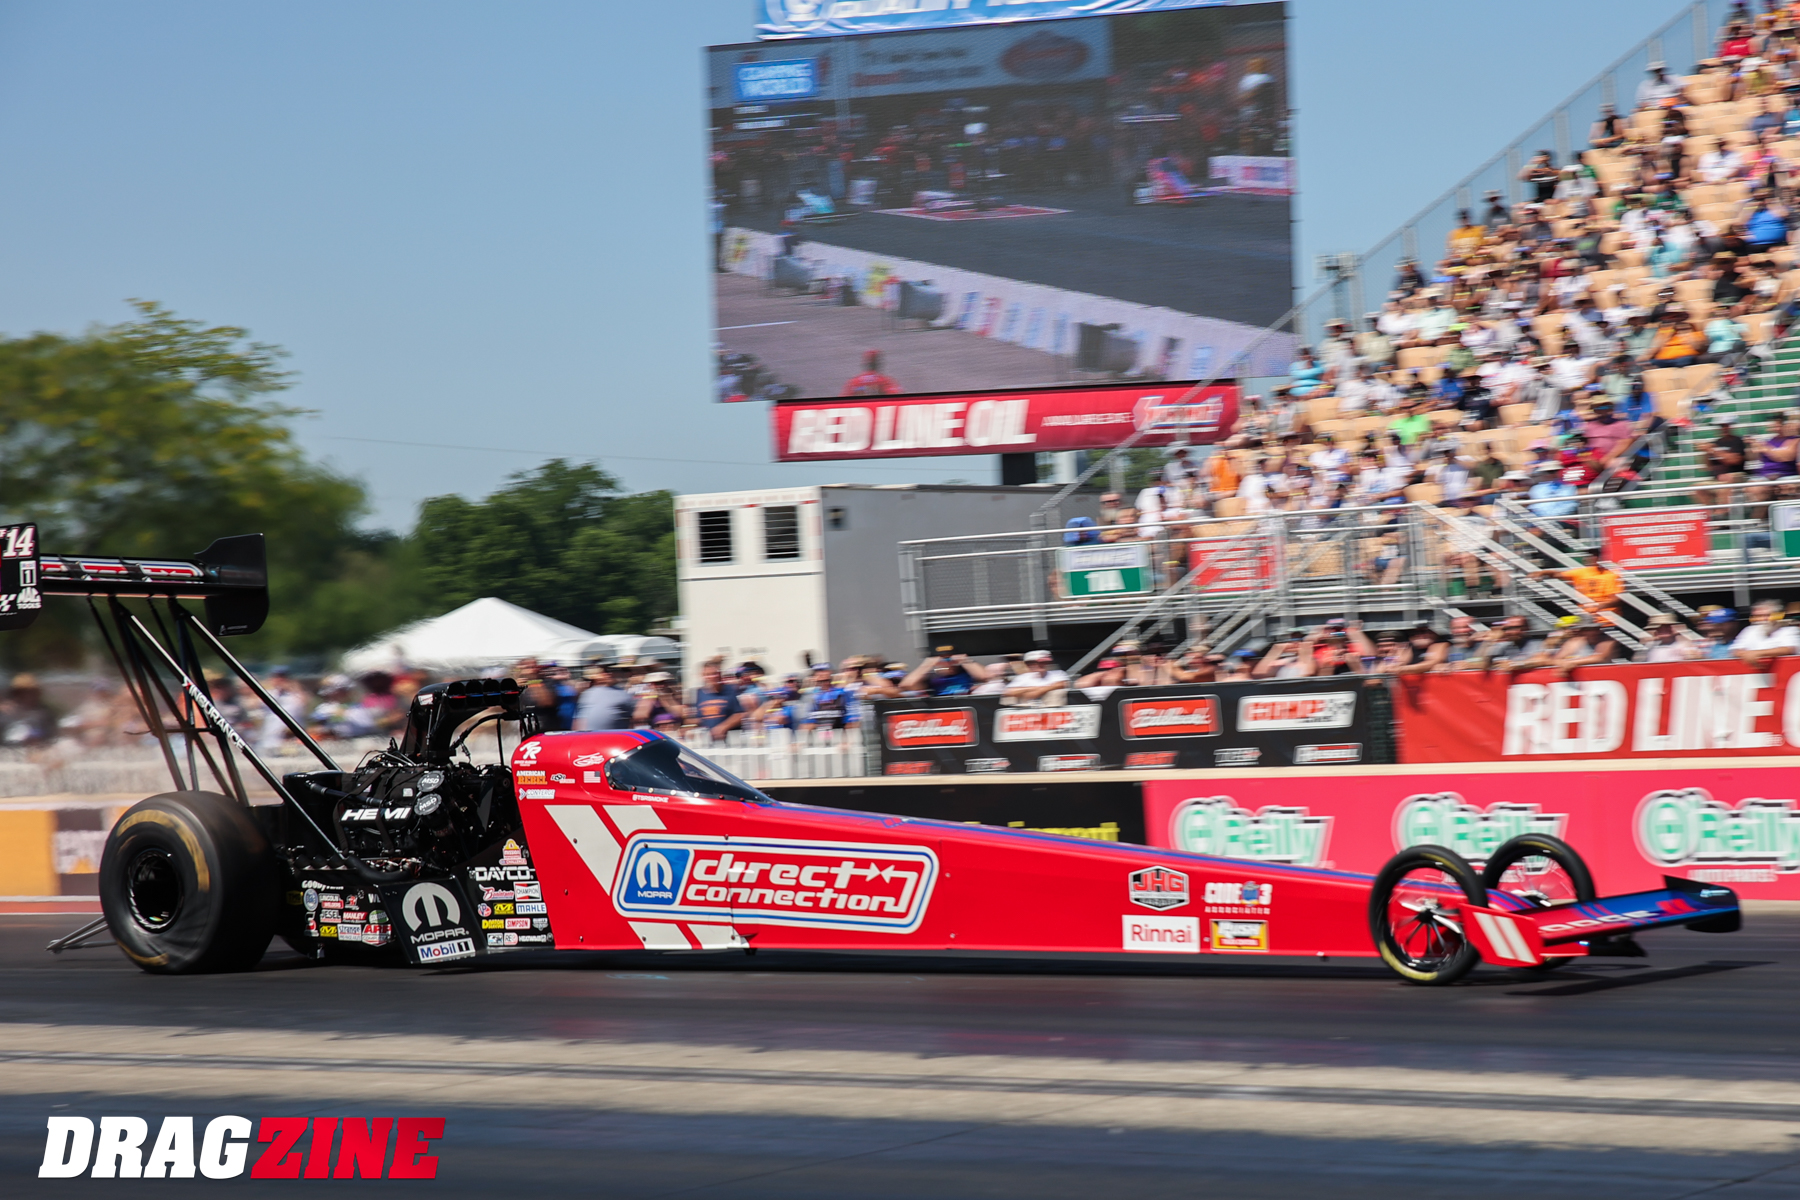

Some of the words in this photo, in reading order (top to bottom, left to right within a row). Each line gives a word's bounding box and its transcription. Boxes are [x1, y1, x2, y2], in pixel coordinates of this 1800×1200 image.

[788, 407, 873, 453] RED
[871, 402, 967, 451] LINE
[965, 399, 1037, 447] OIL
[188, 684, 246, 752] INSURANCE
[1502, 679, 1628, 755] RED
[1631, 672, 1777, 752] LINE
[517, 776, 548, 785] REBEL
[419, 797, 438, 811] MSD
[341, 807, 412, 821] HEMI
[475, 866, 531, 881] DAYCO
[692, 853, 858, 889] direct
[1133, 870, 1185, 892] JHG
[516, 885, 539, 896] CHAMPION
[637, 890, 673, 899] MOPAR
[685, 884, 903, 914] connection
[517, 904, 546, 914] MAHLE
[506, 920, 529, 929] SIMPSON
[410, 927, 466, 944] MOPAR
[1131, 924, 1192, 943] Rinnai
[420, 943, 456, 959] Mobil
